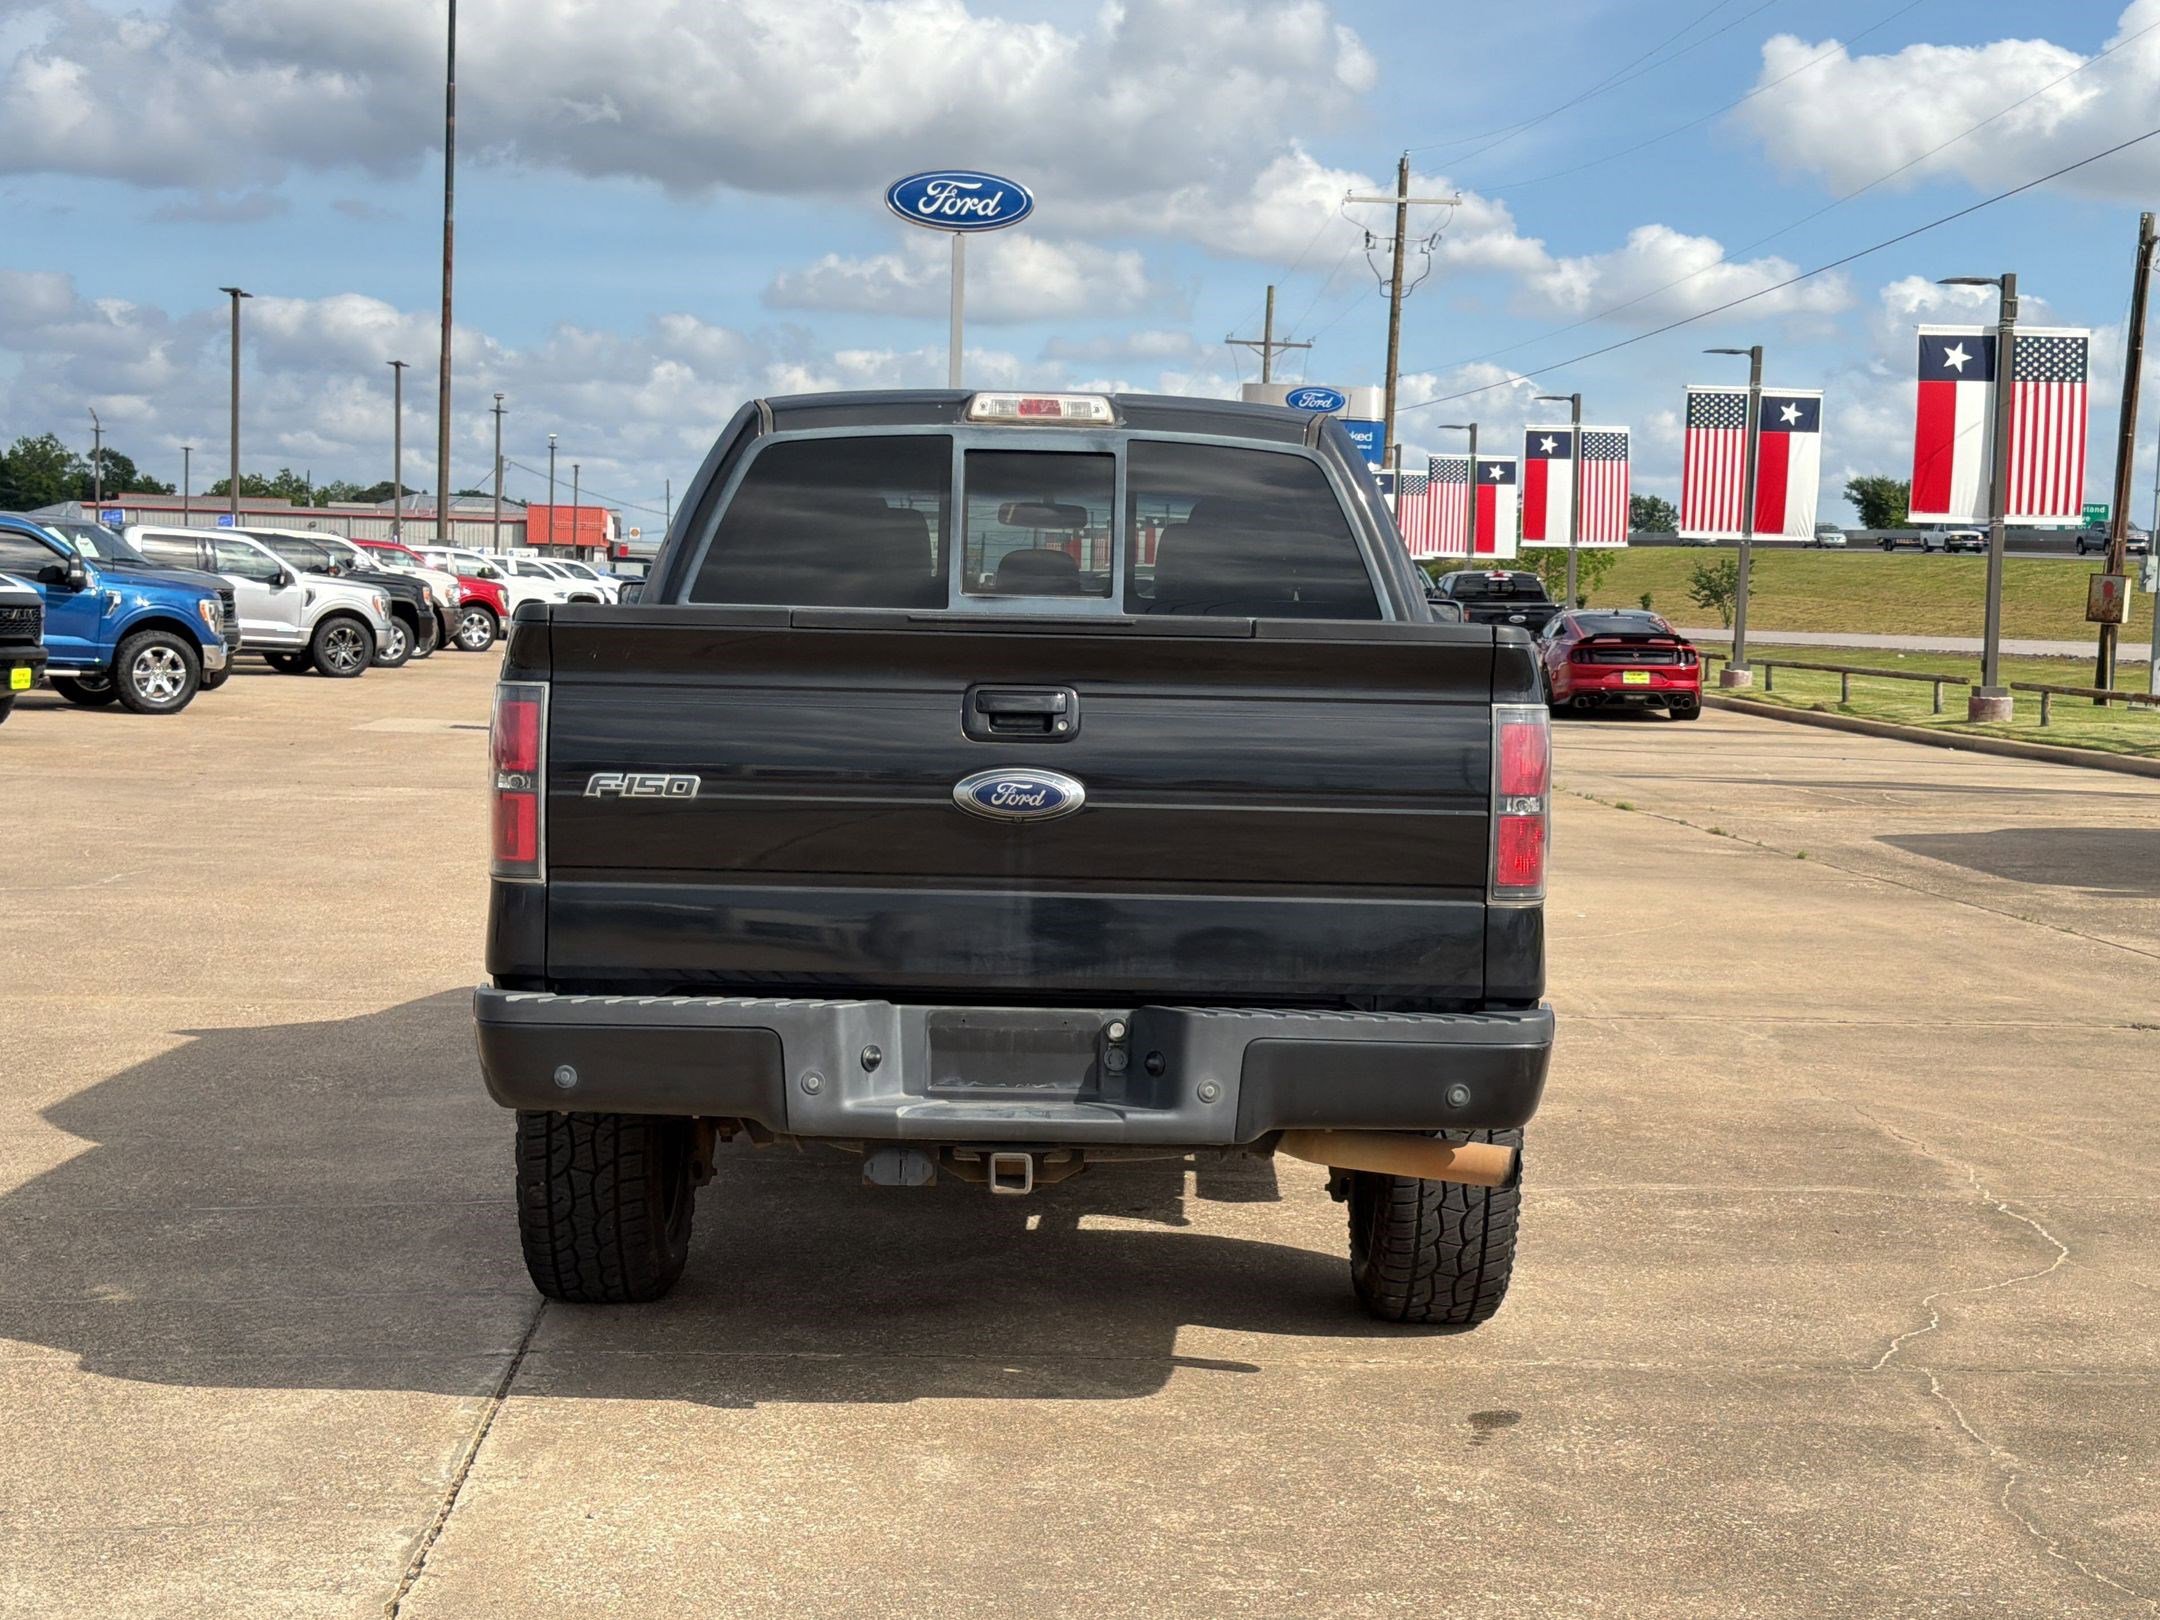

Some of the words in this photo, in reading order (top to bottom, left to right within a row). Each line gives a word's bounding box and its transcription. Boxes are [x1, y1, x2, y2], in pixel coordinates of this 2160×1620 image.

[918, 180, 1003, 216] Ford
[1299, 391, 1333, 409] Ford
[582, 772, 701, 799] F-150
[991, 782, 1046, 807] Ford
